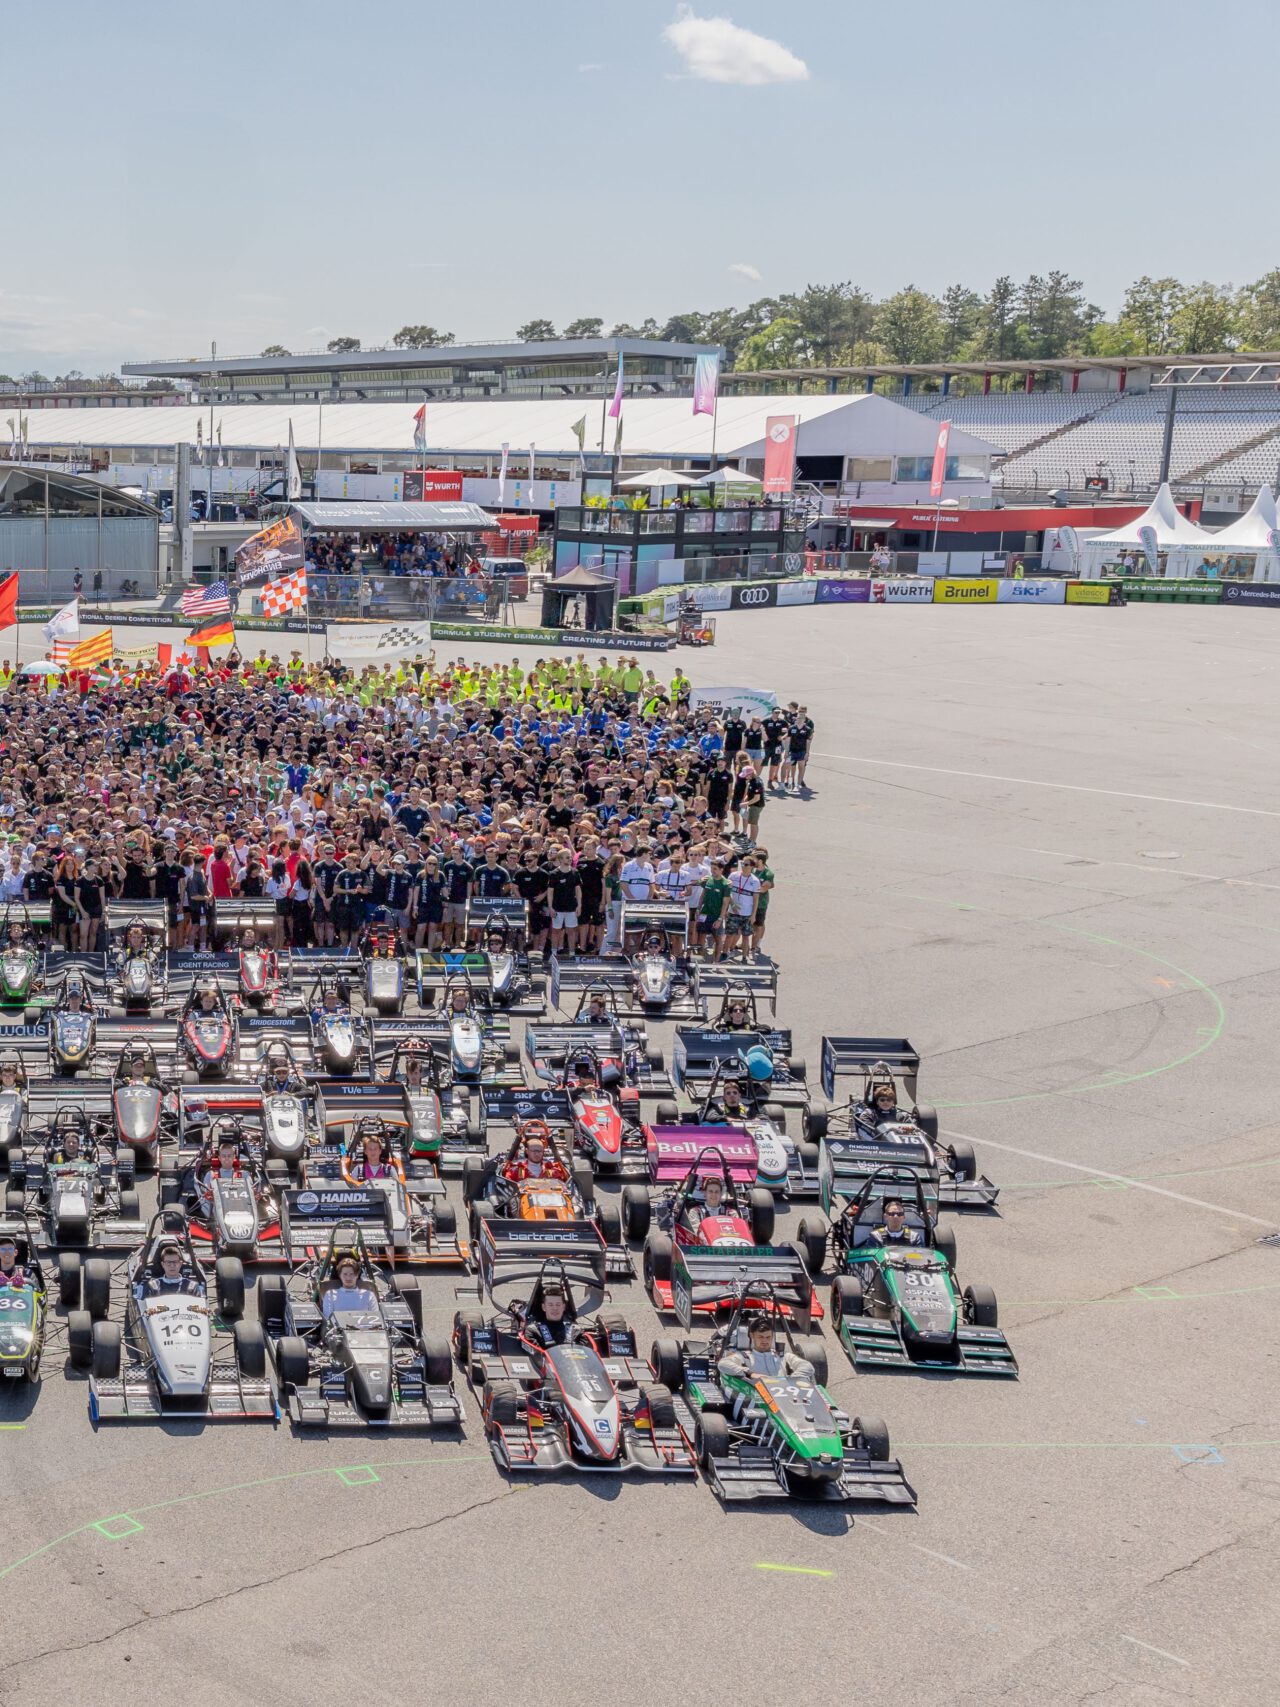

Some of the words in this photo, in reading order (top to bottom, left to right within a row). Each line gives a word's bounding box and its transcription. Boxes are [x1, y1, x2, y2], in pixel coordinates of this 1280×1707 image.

[888, 585, 932, 596] WÜRTH
[944, 585, 989, 597] Brunel
[1012, 587, 1047, 596] SKF
[1141, 585, 1177, 593] STUDENT
[1179, 586, 1220, 594] GERMANY
[1240, 590, 1280, 600] Mercedes-Ben
[248, 619, 283, 628] GERMANY
[288, 622, 323, 630] CREATING
[433, 629, 471, 637] FORMULA
[473, 631, 512, 639] STUDENT
[514, 632, 557, 641] GERMANY
[562, 635, 606, 644] CREATING
[616, 638, 652, 647] FUTURE
[422, 954, 484, 971] NXP
[373, 966, 399, 975] 20
[249, 1018, 297, 1026] BRIDGESTONE
[124, 1088, 152, 1098] 173
[341, 1086, 362, 1094] TU/e
[513, 1092, 536, 1100] SKF
[272, 1100, 294, 1108] 28
[413, 1111, 437, 1119] 172
[719, 1143, 752, 1156] Lui
[221, 1190, 248, 1199] 114
[320, 1193, 370, 1204] HAINDL
[508, 1231, 579, 1241] bertrandt
[690, 1246, 774, 1256] SCHAEFFLER
[906, 1273, 934, 1287] 80
[353, 1315, 380, 1326] 72
[770, 1385, 813, 1400] 297
